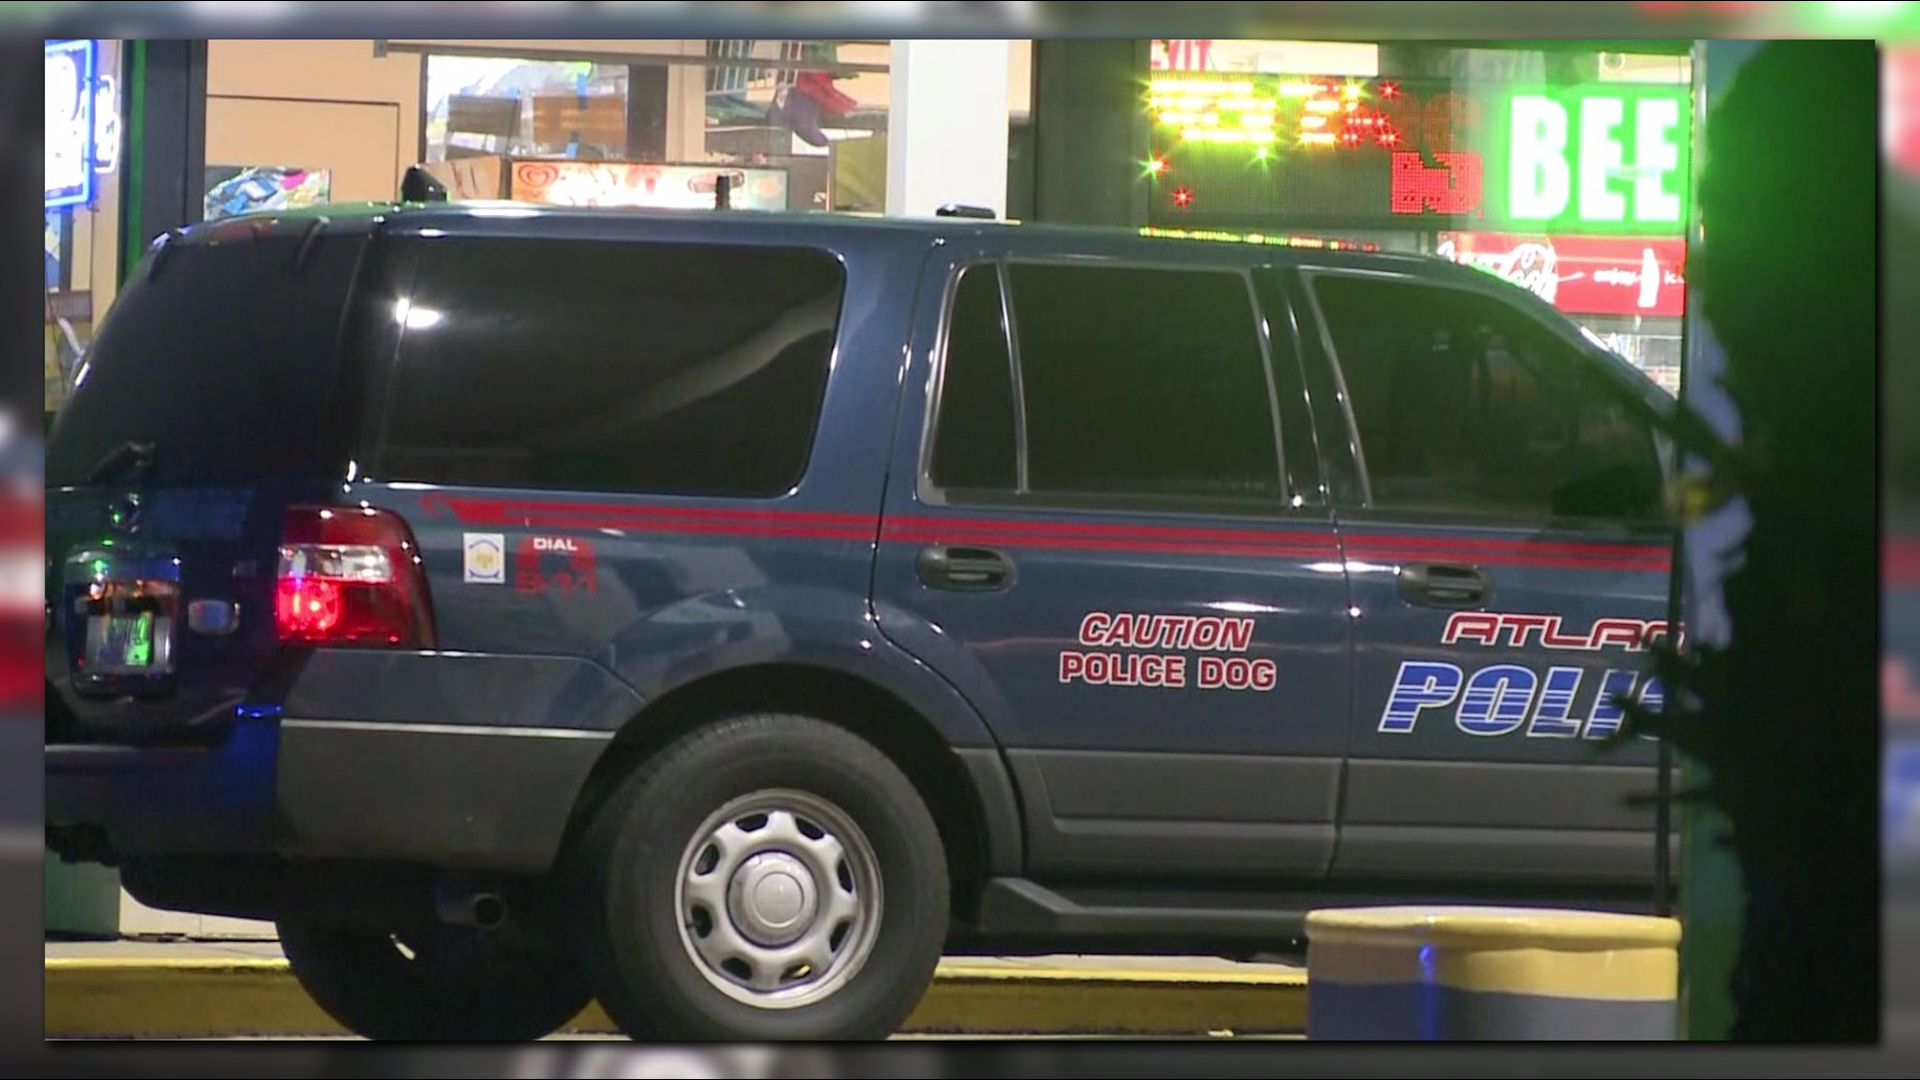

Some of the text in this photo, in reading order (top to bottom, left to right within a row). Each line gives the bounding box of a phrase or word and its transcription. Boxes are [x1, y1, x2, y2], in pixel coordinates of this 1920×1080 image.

[1510, 94, 1681, 220] BEE
[532, 537, 579, 551] DIAL
[1079, 612, 1255, 652] CAUTION
[1059, 650, 1277, 692] POLICE DOG
